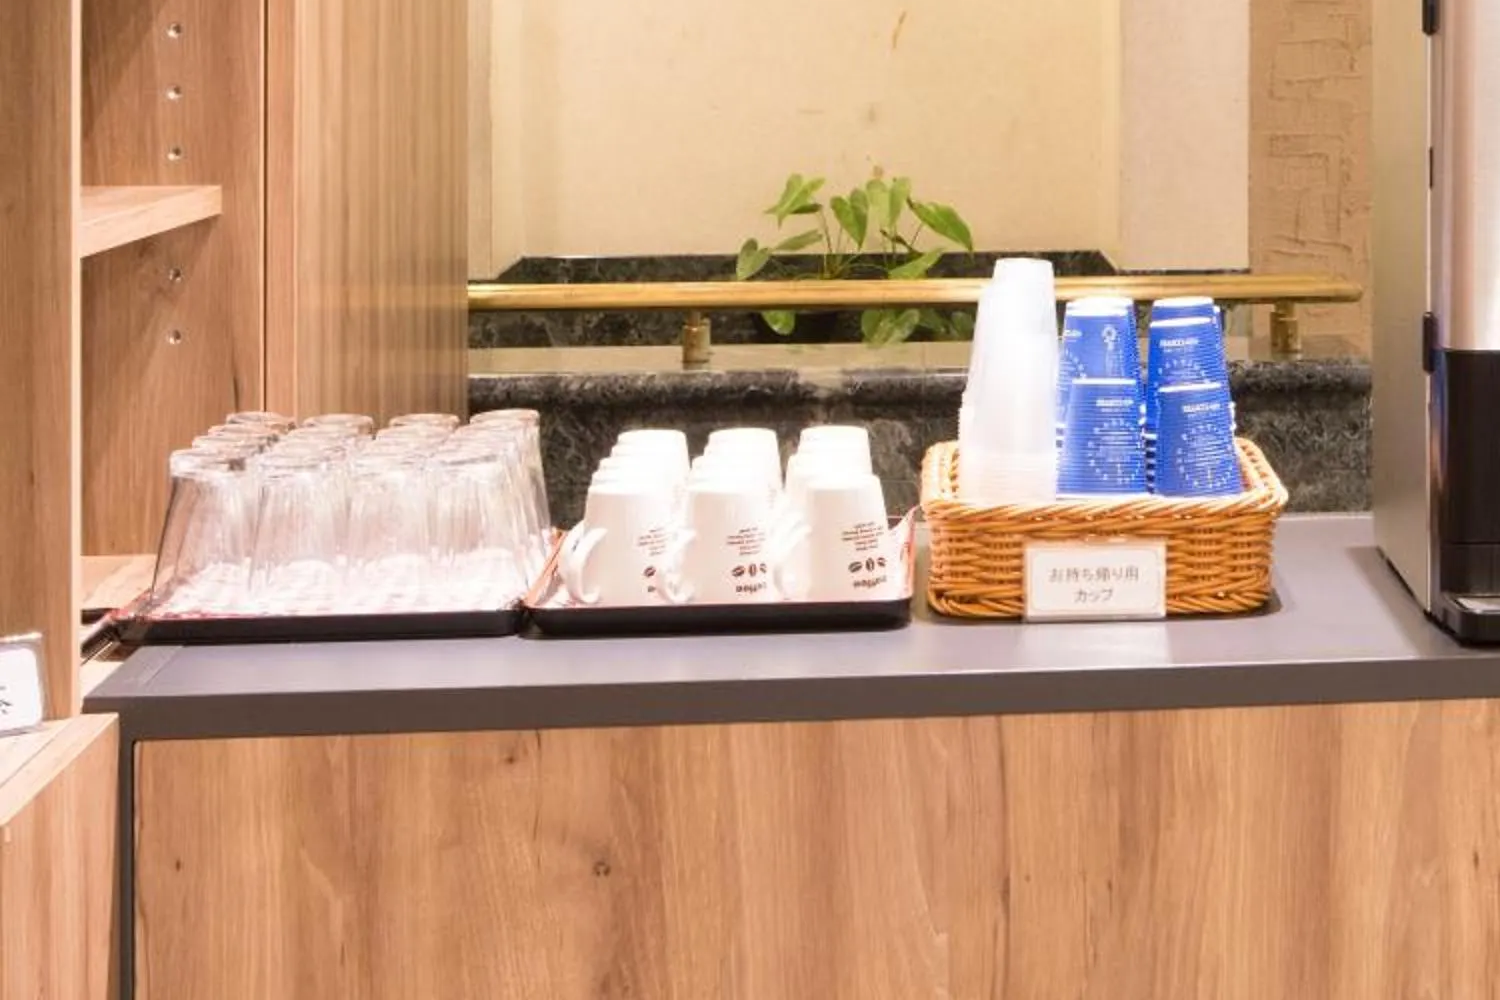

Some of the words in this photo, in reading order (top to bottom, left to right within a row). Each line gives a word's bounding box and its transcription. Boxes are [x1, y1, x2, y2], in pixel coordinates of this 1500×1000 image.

[1048, 565, 1139, 582] お持ち帰り用
[1075, 587, 1114, 602] カップ
